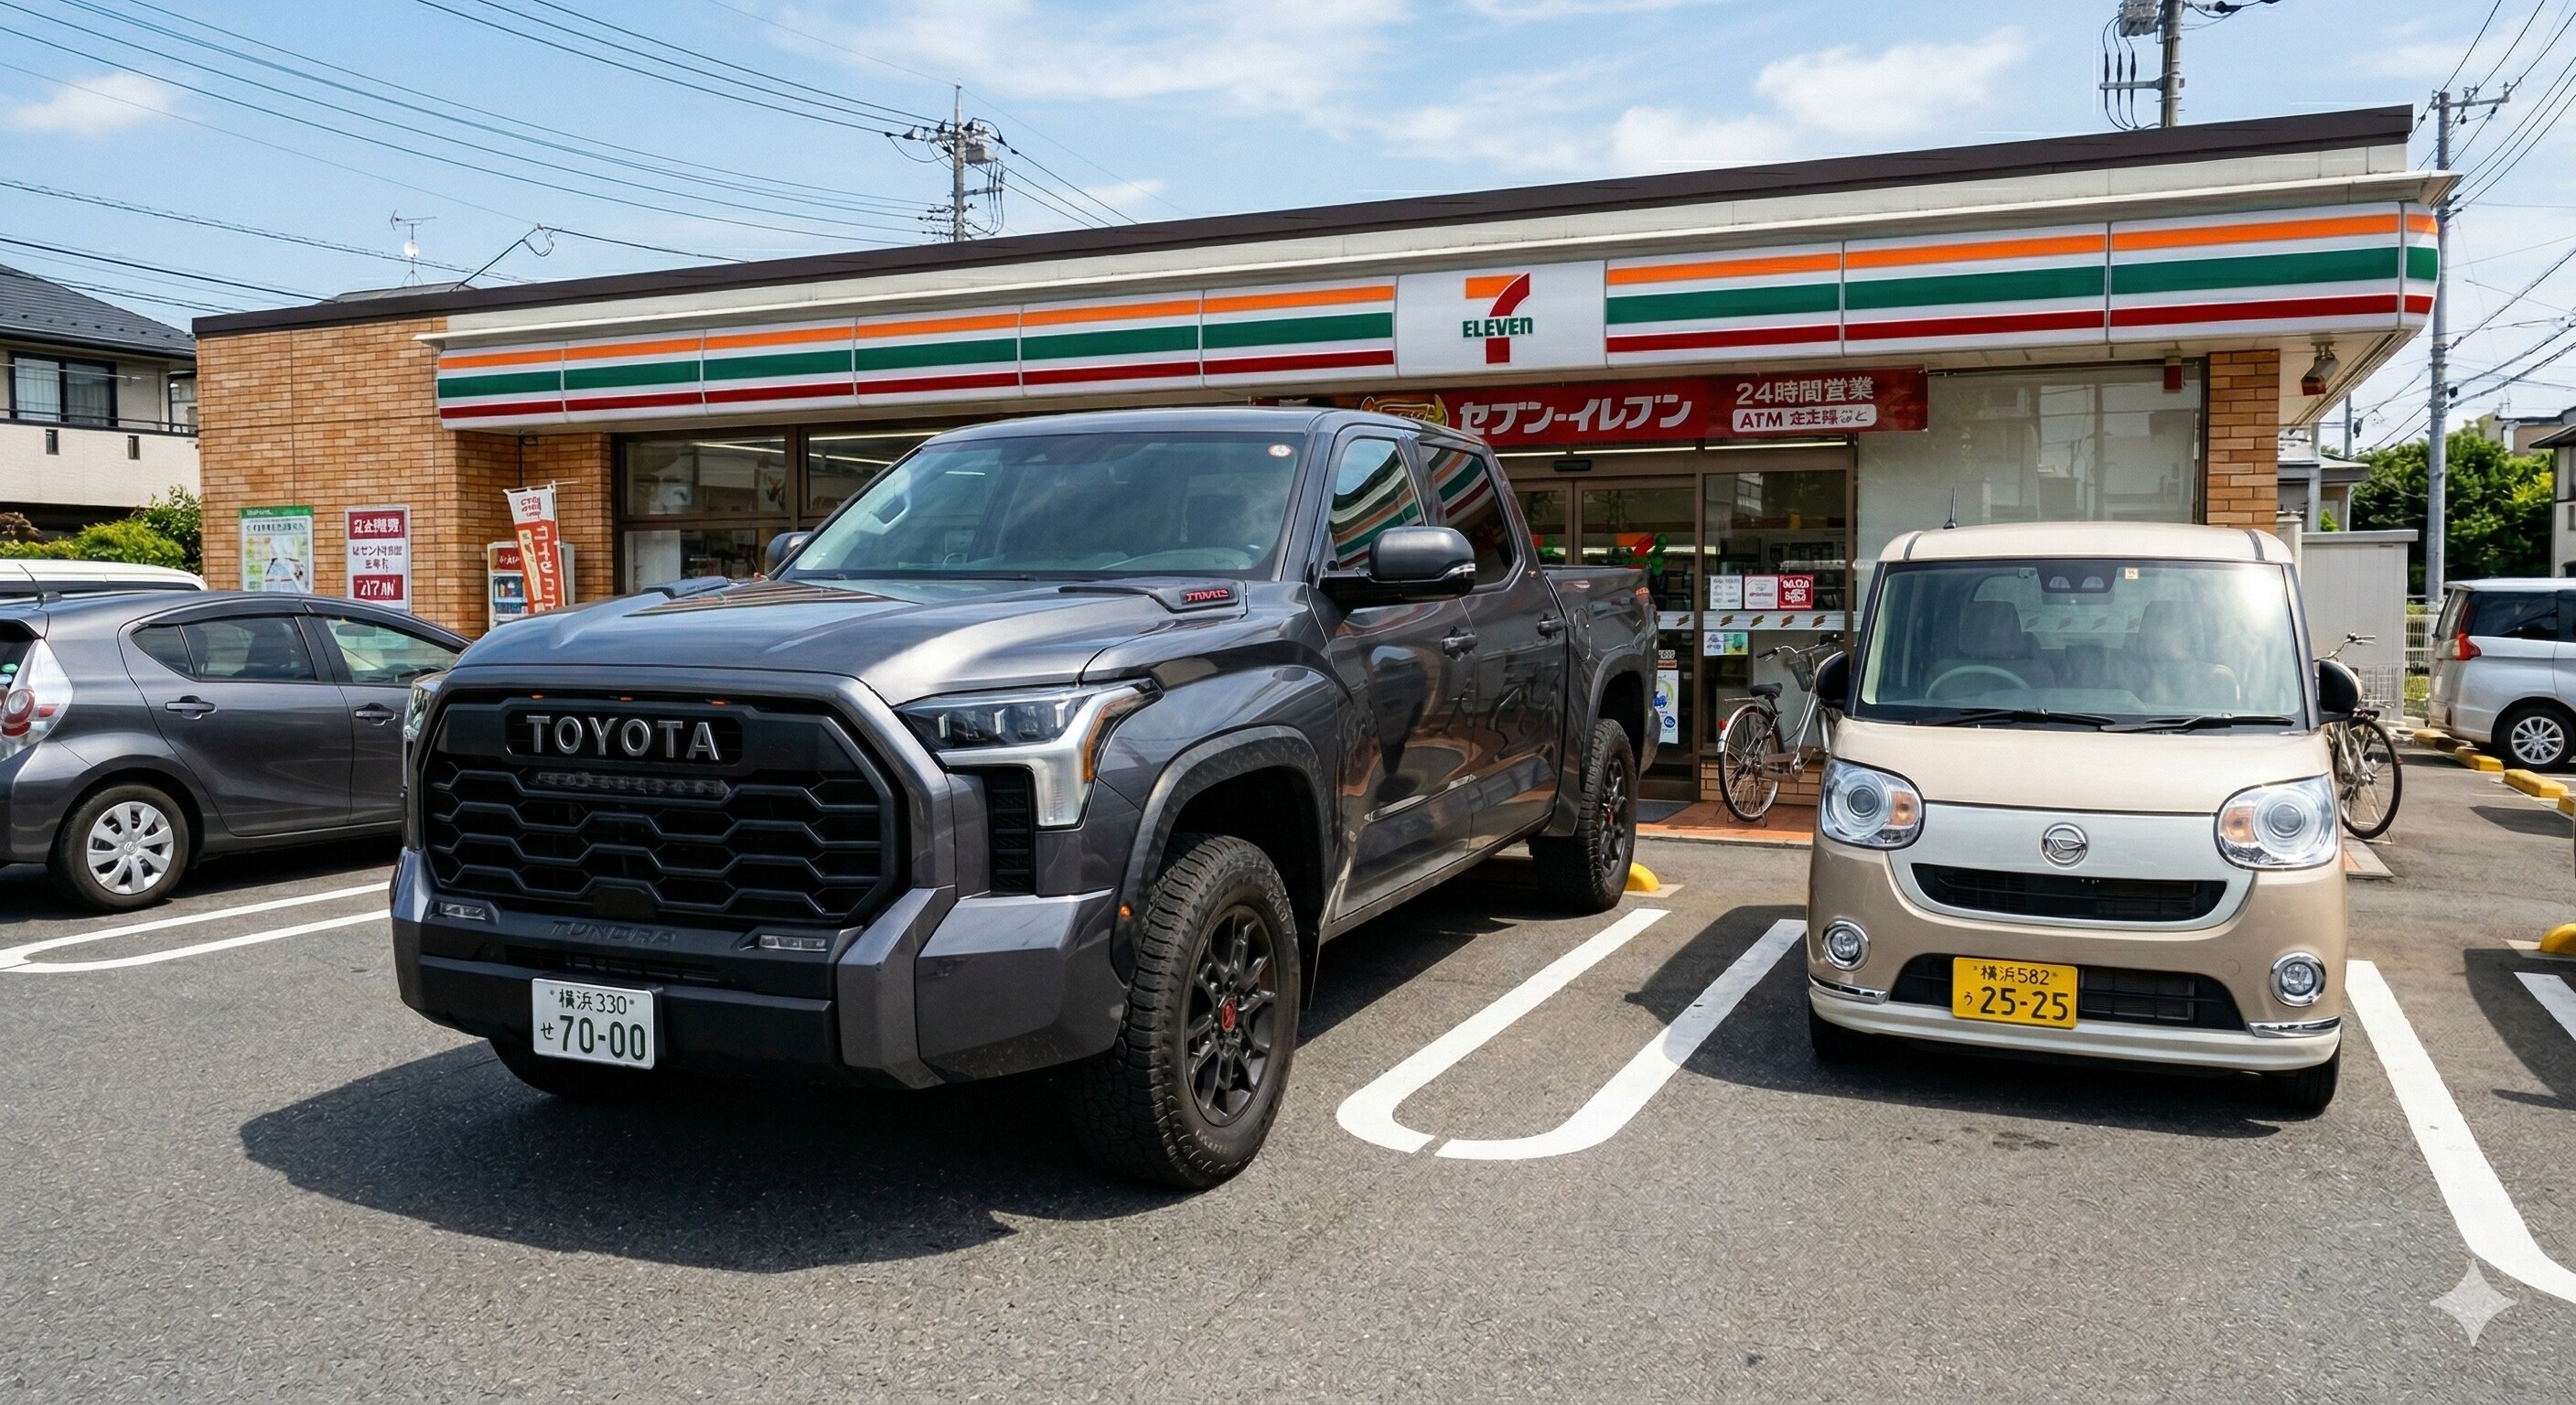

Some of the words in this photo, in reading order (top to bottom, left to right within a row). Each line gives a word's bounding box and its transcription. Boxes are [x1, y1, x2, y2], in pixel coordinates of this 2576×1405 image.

[1735, 376, 1874, 405] 24時間営業
[1739, 412, 1784, 429] ATM
[526, 715, 720, 761] TOYOTA
[551, 920, 676, 946] TUNDRA
[1964, 992, 1973, 1006] う
[1980, 986, 2069, 1021] 25-25
[541, 1022, 554, 1040] せ
[559, 1014, 646, 1061] 70-00
